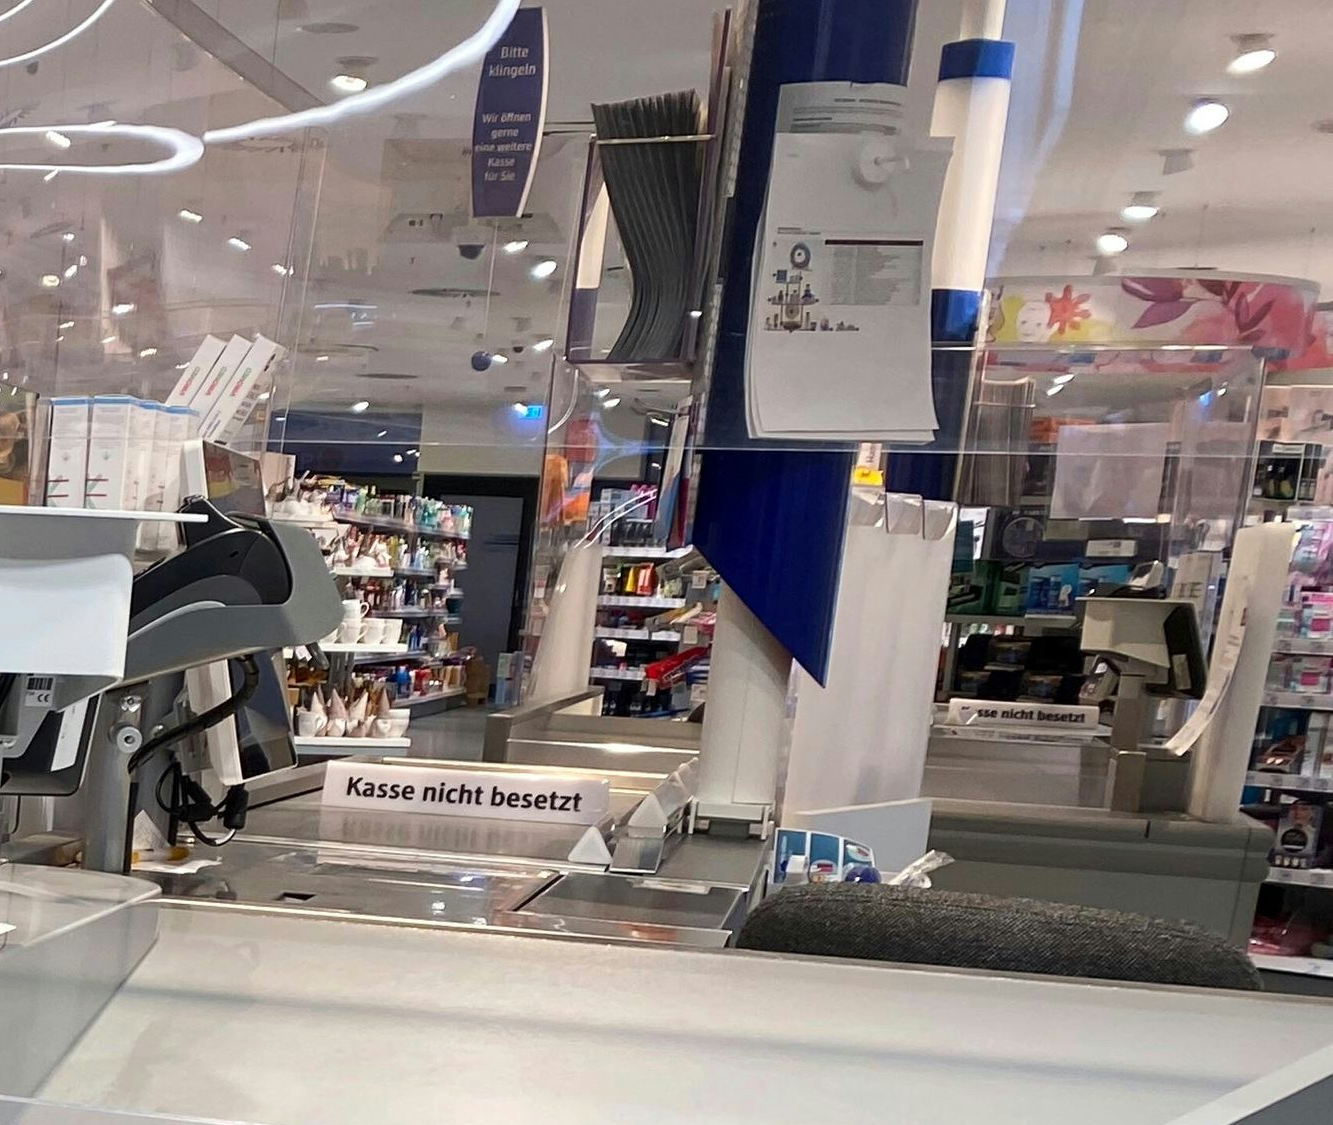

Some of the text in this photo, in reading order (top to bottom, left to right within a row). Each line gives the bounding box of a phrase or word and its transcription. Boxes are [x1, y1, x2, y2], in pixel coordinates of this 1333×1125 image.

[501, 47, 529, 58] Bitte
[489, 64, 536, 78] klingeln
[482, 112, 532, 123] Wir öffnen
[491, 129, 519, 140] gerne
[497, 142, 533, 152] weitere
[488, 157, 515, 168] Kasse
[484, 171, 515, 182] für Sie
[1001, 708, 1034, 721] nicht
[1036, 710, 1086, 723] besetzt
[346, 776, 583, 813] Kasse nicht besetzt
